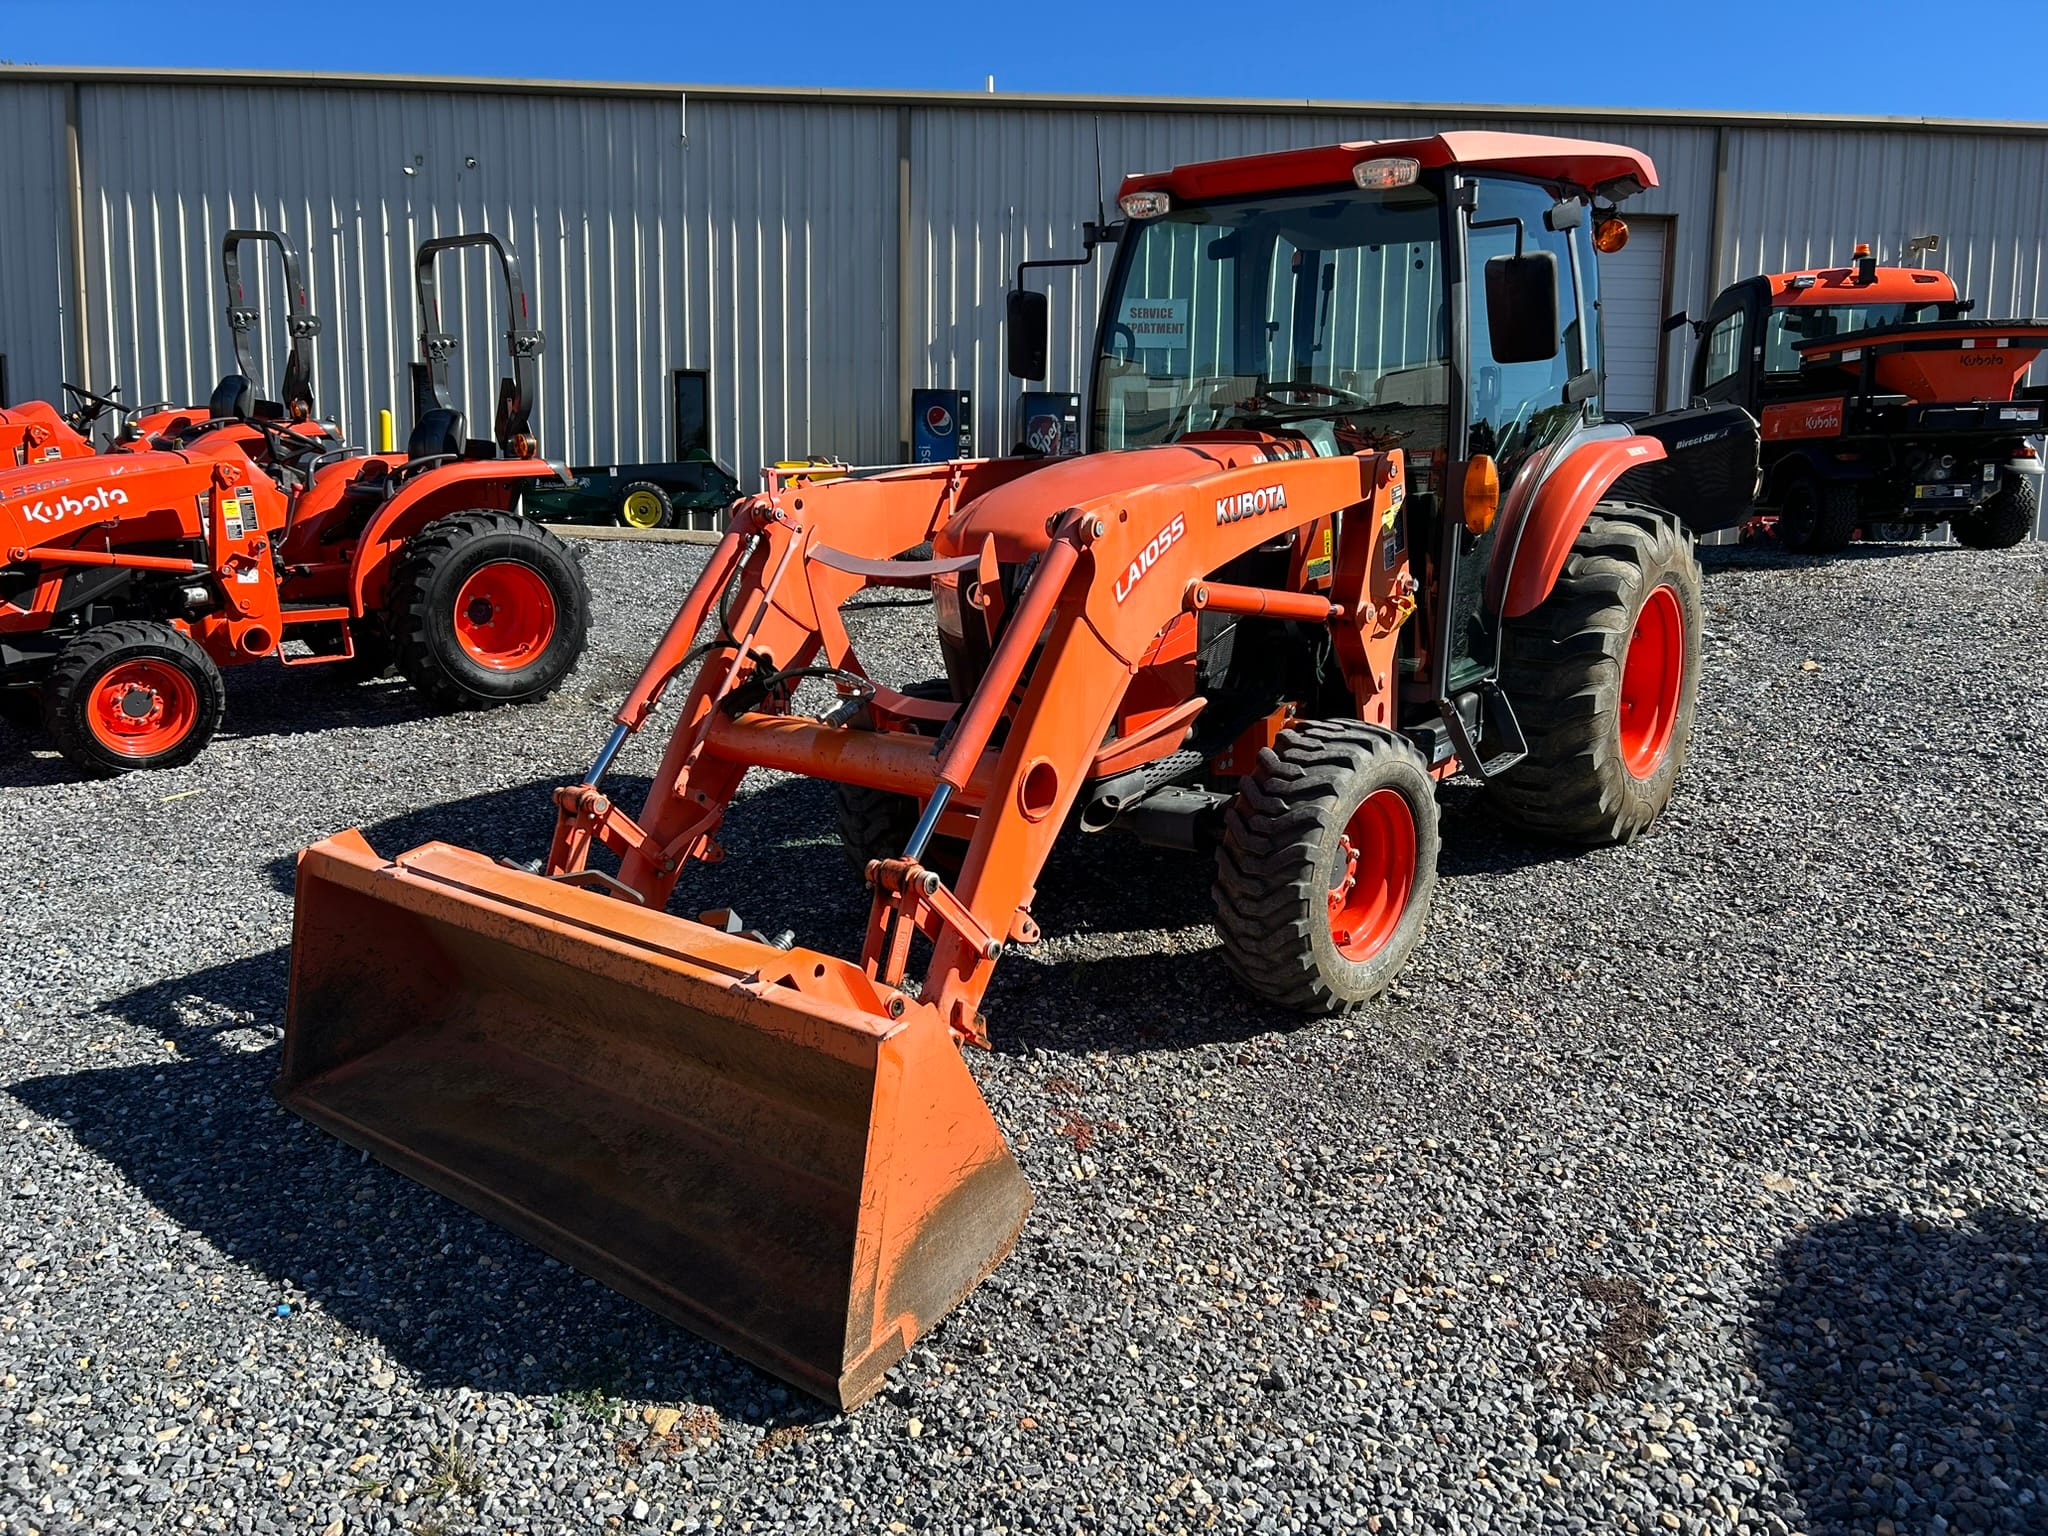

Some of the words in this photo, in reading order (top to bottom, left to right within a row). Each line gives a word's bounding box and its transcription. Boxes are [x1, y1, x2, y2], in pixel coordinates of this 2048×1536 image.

[1130, 307, 1174, 319] SERVICE
[1126, 322, 1185, 335] EPARTMENT
[1960, 354, 2004, 366] Kubota
[1805, 415, 1839, 430] Kubota
[1029, 428, 1043, 449] Dr
[1675, 436, 1703, 450] Direct
[22, 487, 129, 523] Kubota
[1216, 484, 1287, 526] KUBOTA
[1115, 513, 1185, 604] LA1055
